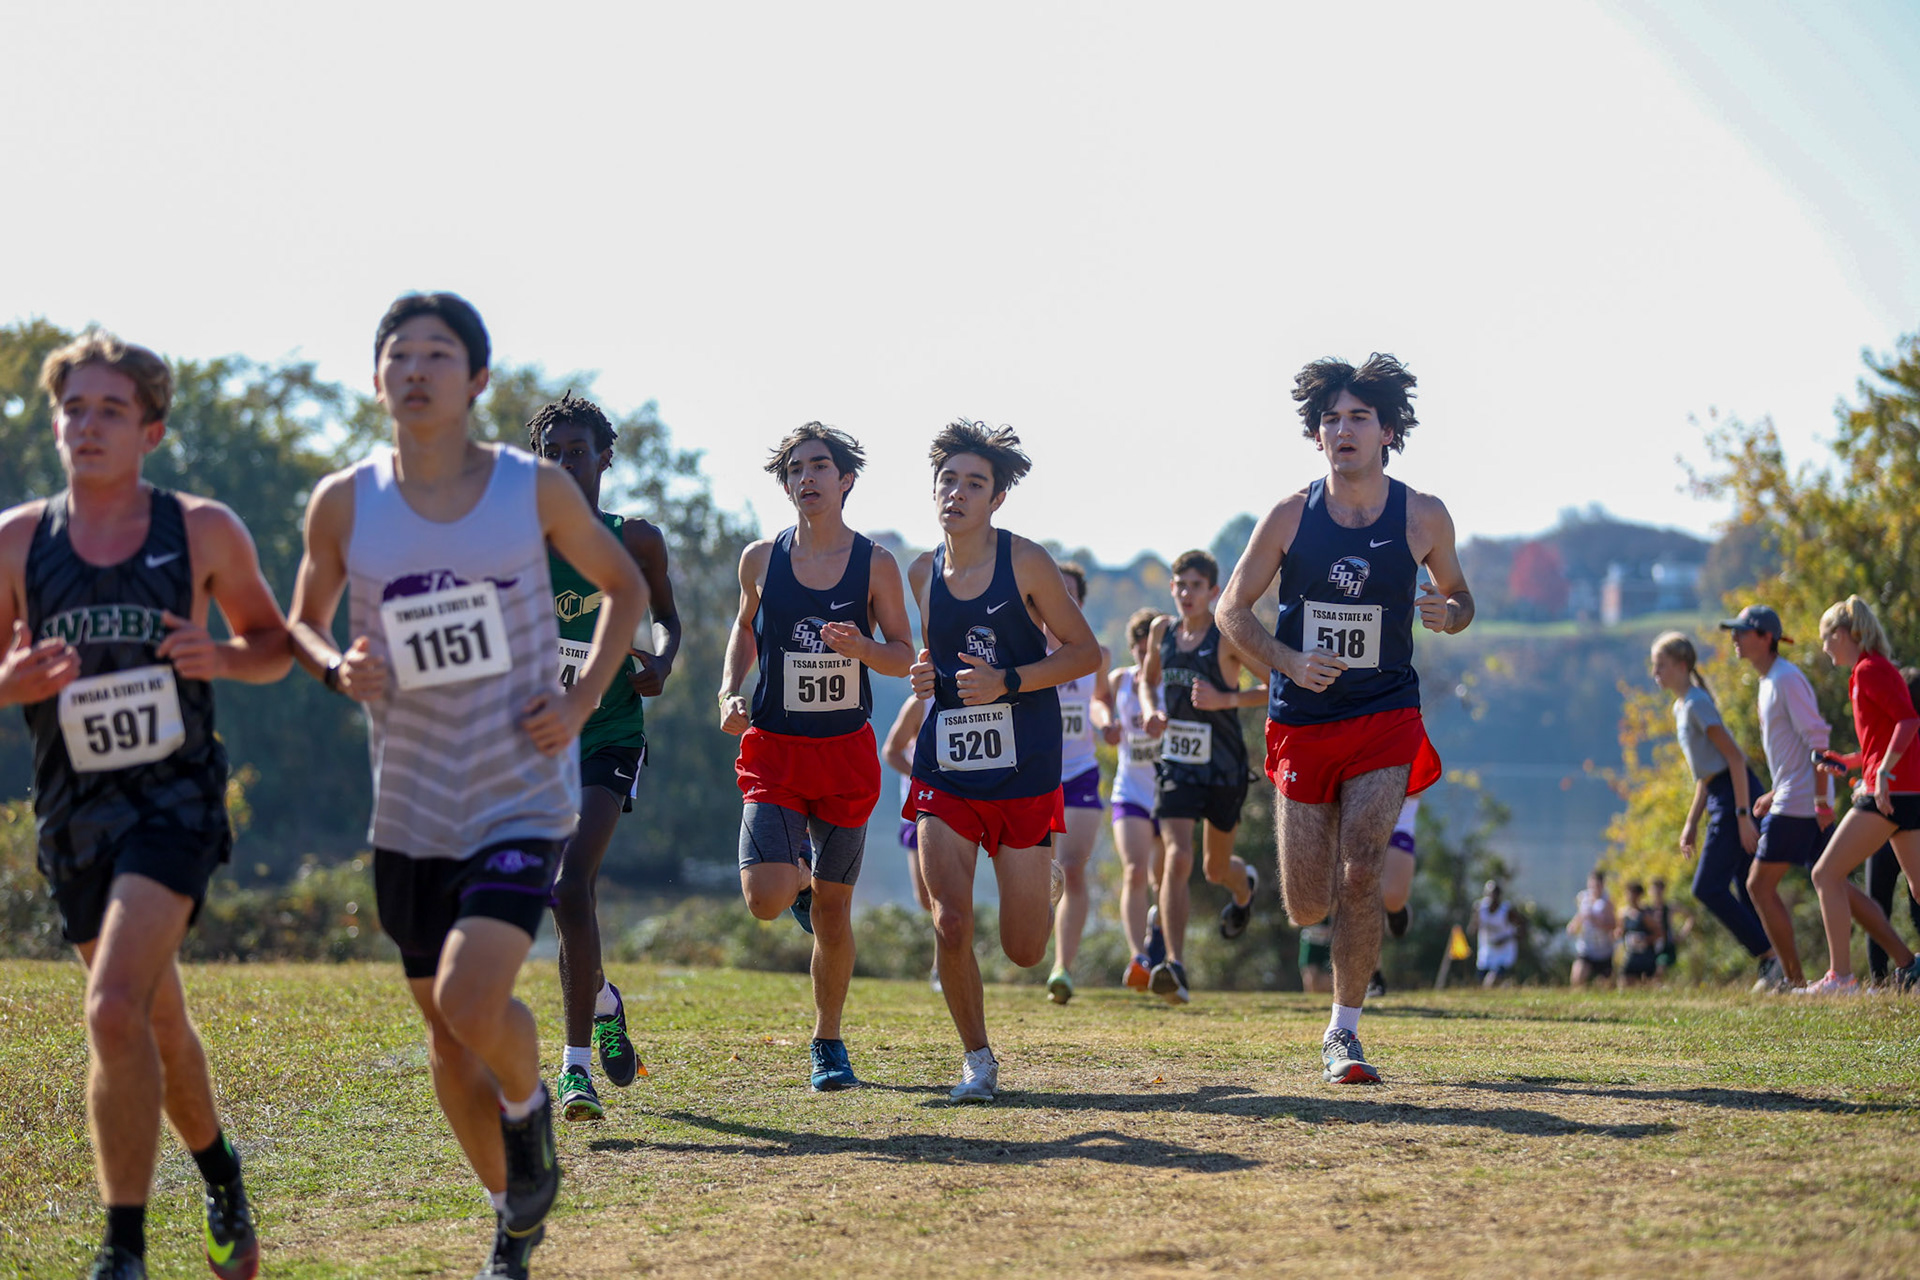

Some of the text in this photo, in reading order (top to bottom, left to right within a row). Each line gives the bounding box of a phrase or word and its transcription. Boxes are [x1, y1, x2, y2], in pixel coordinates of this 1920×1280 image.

[1330, 564, 1362, 596] SBA
[1312, 609, 1373, 622] TSSAA STATE XC
[404, 618, 491, 672] 1151
[565, 647, 589, 660] STATE
[1317, 626, 1366, 659] 518
[793, 658, 852, 670] TSSAA STATE XC
[798, 674, 846, 703] 519
[83, 703, 159, 756] 597
[944, 711, 1003, 726] TSSAA STATE XC
[1062, 714, 1083, 734] 70
[948, 728, 1002, 762] 520
[1170, 735, 1203, 757] 592
